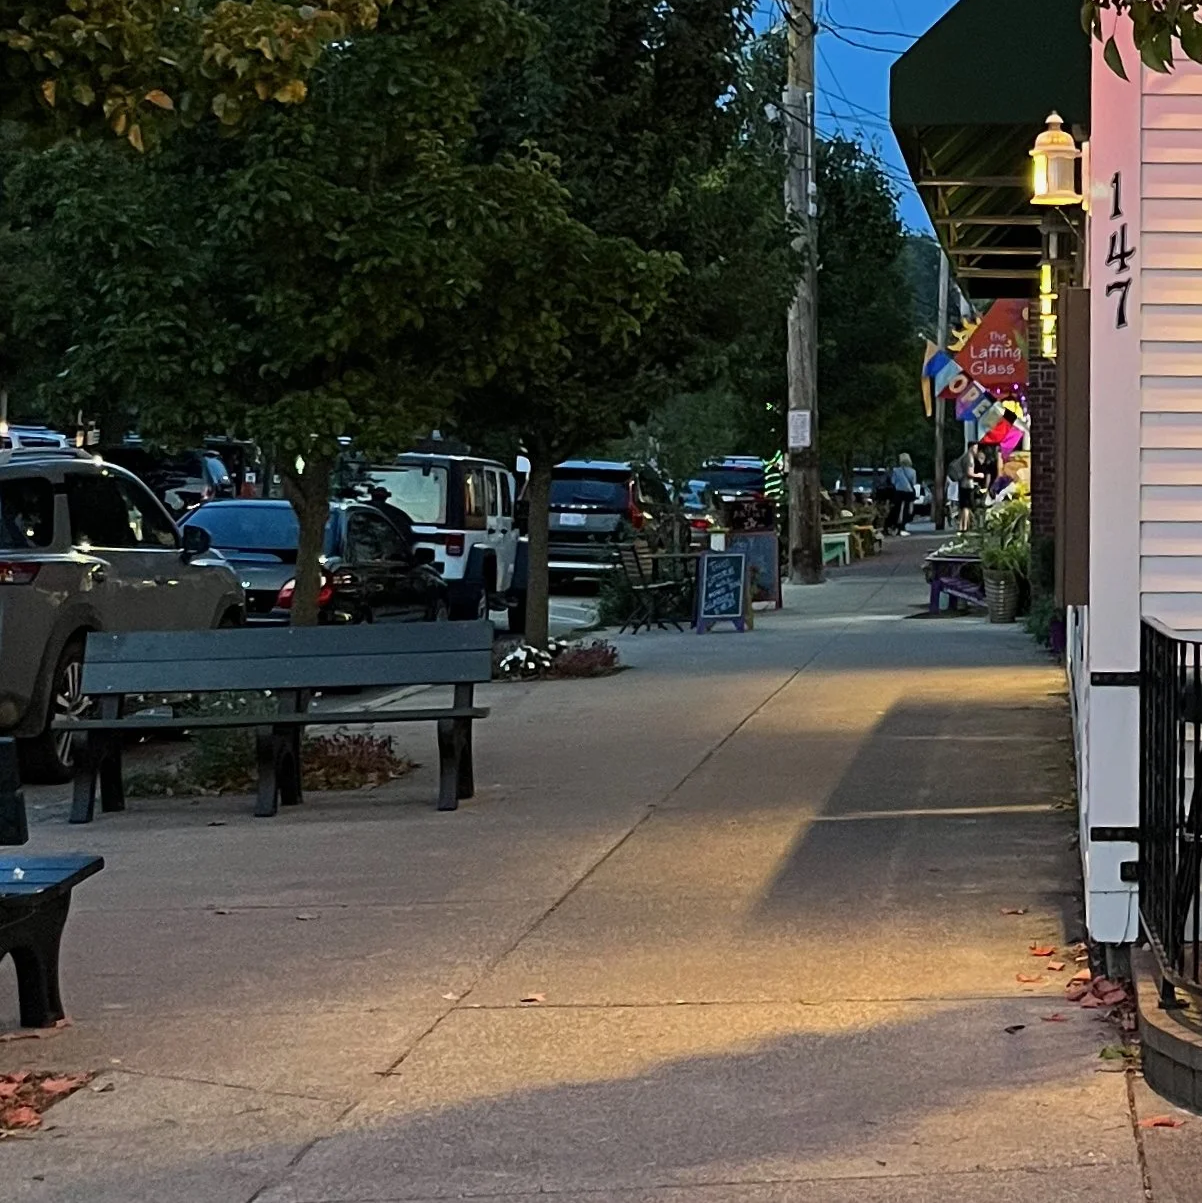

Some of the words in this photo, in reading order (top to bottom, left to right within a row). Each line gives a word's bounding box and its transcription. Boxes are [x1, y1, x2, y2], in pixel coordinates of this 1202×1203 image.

[1105, 171, 1137, 330] 147
[989, 331, 1008, 342] The
[970, 346, 1022, 361] Laffing
[970, 360, 1016, 375] Glass
